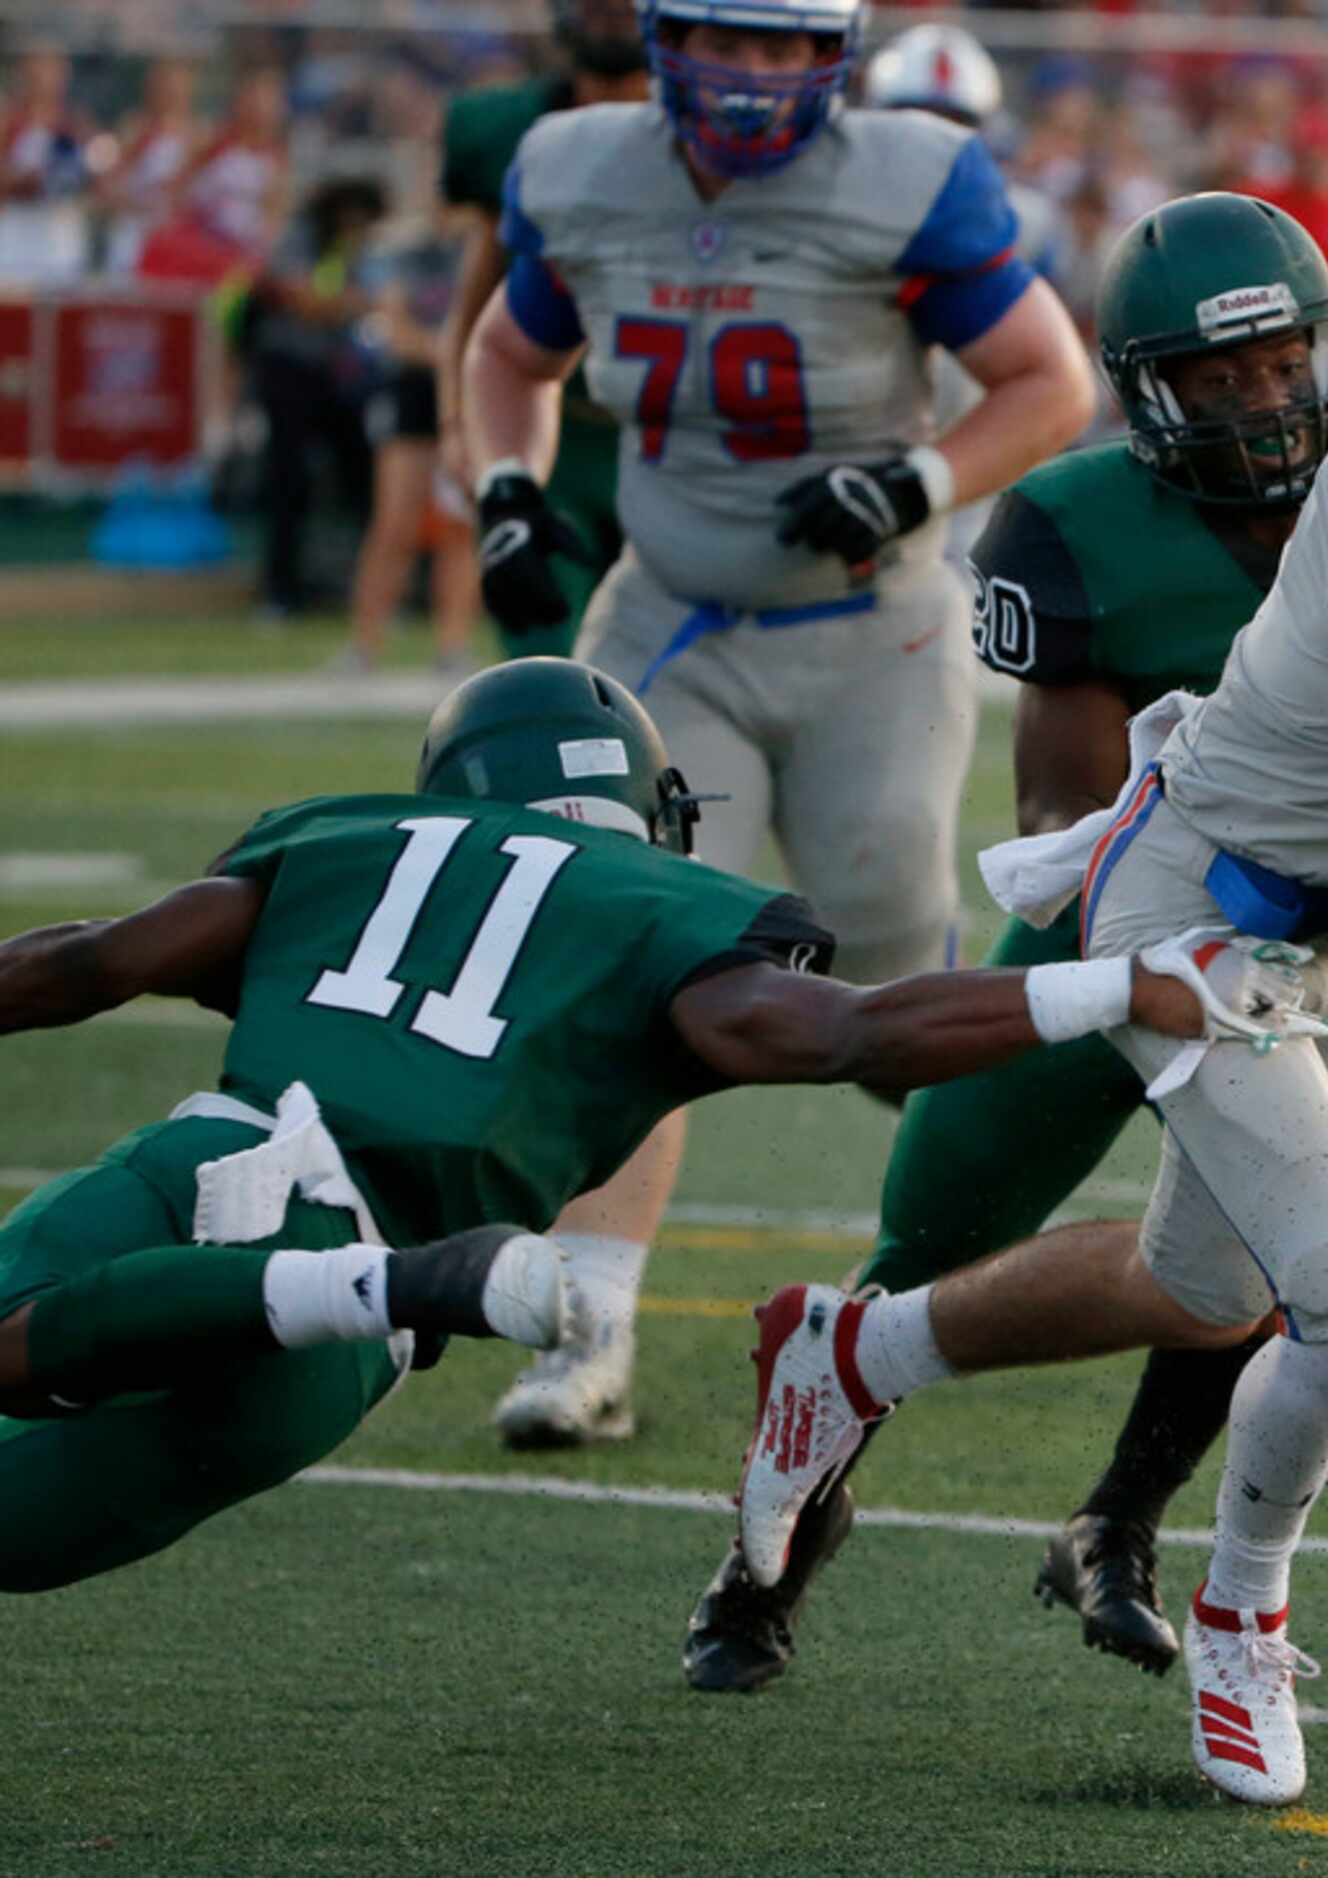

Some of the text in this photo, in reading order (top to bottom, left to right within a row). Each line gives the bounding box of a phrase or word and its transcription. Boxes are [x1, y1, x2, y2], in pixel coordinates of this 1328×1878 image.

[1218, 289, 1270, 313] Riddell
[614, 316, 813, 464] 79
[304, 816, 580, 1060] 11
